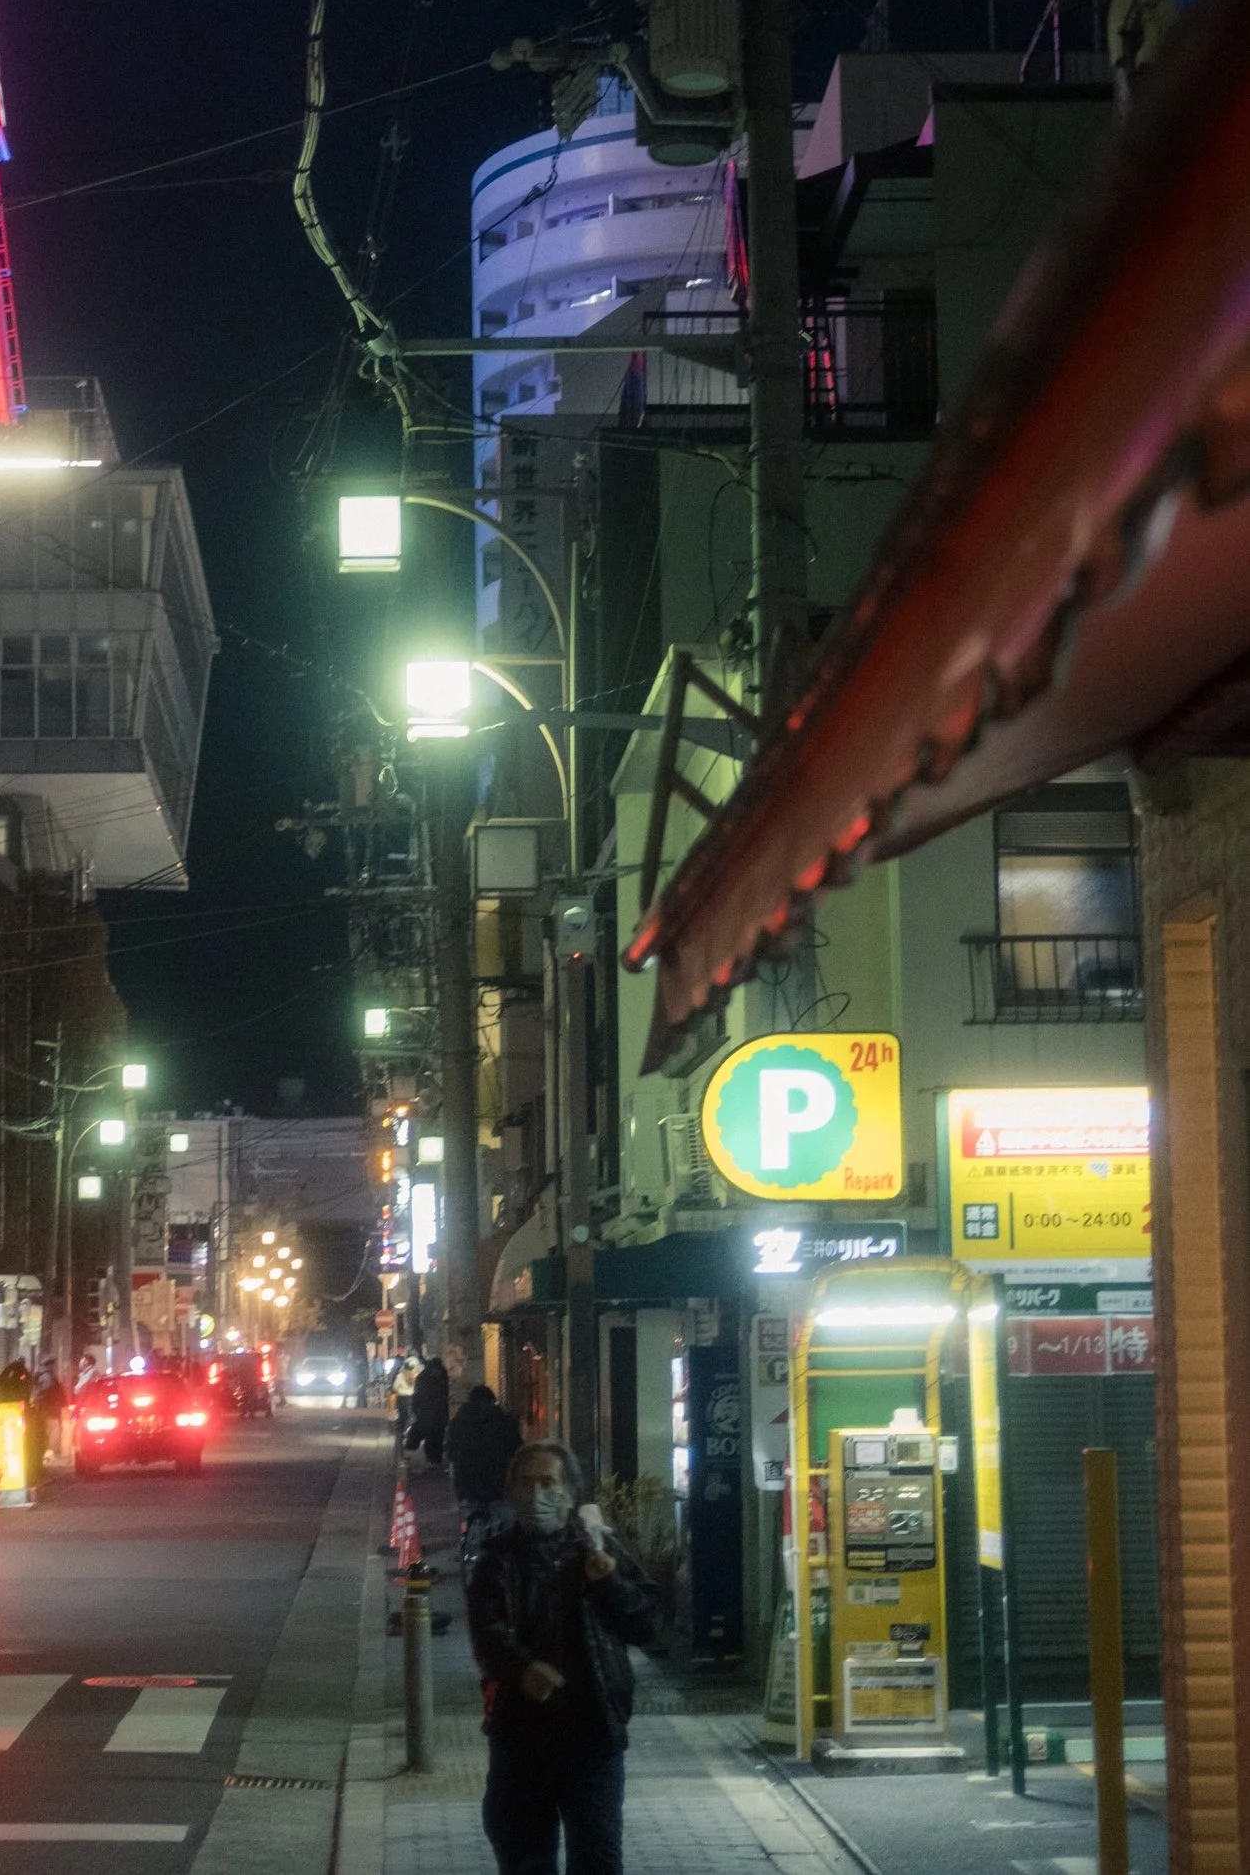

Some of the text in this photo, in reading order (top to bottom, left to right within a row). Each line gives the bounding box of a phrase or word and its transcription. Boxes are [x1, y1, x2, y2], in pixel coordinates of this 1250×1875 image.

[850, 1041, 893, 1073] 24h
[759, 1068, 837, 1170] P
[844, 1166, 895, 1194] Repark
[802, 1236, 897, 1261] 三井のリパーク
